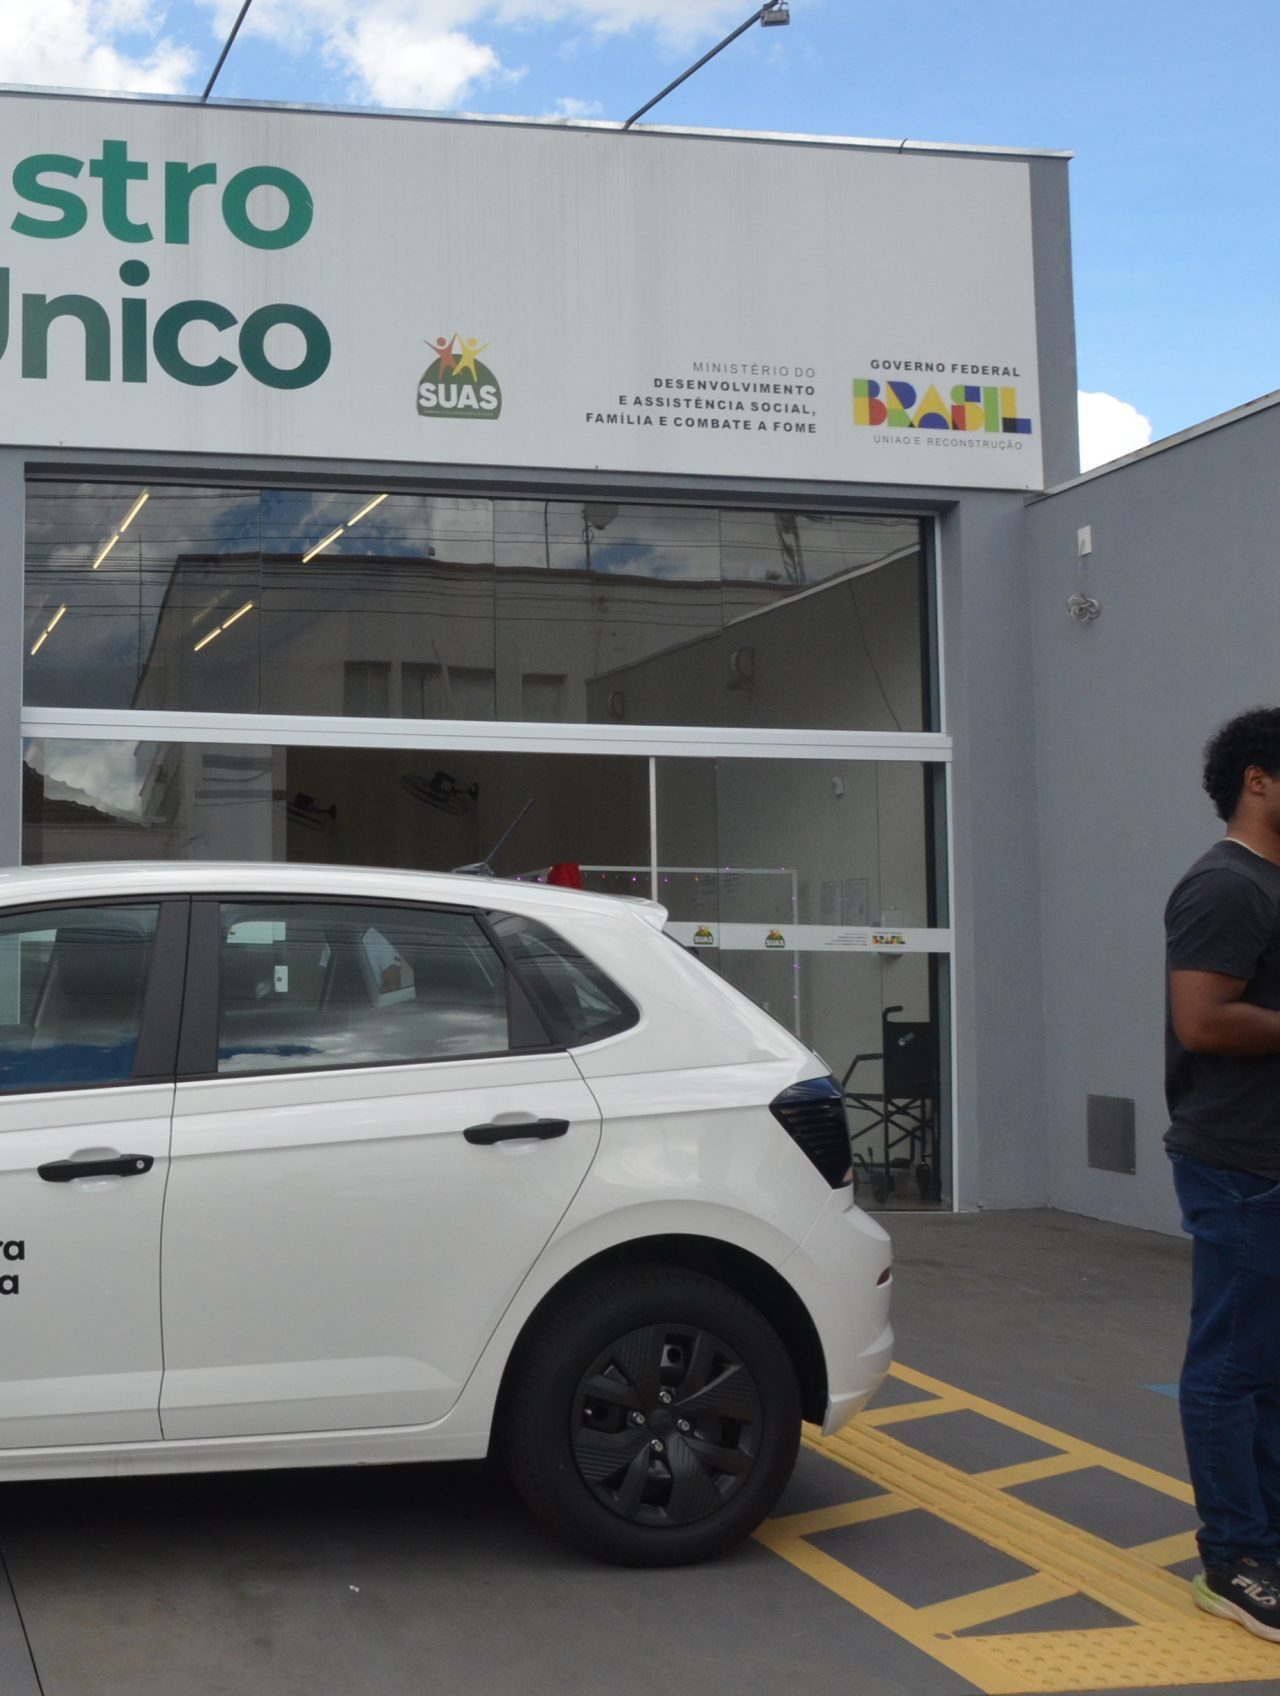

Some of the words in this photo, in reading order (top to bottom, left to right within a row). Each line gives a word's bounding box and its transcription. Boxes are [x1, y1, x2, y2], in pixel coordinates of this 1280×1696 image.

[693, 361, 789, 377] MINISTÉRIO
[794, 366, 816, 378] DO
[870, 359, 945, 373] GOVERNO
[951, 364, 1020, 377] FEDERAL
[419, 383, 498, 410] SUAS
[654, 378, 816, 396] DESENVOLVIMENTO
[619, 395, 627, 405] E
[633, 395, 745, 412] ASSISTÊNCIA
[750, 401, 817, 417] SOCIAL,
[853, 378, 1032, 434] BRASIL
[586, 411, 653, 426] FAMÍLIA
[659, 416, 668, 427] E
[673, 417, 752, 430] COMBATE
[757, 421, 768, 431] A
[773, 422, 817, 434] FOME
[914, 436, 921, 445] E
[926, 437, 1023, 451] RECONSTRUÇÃO
